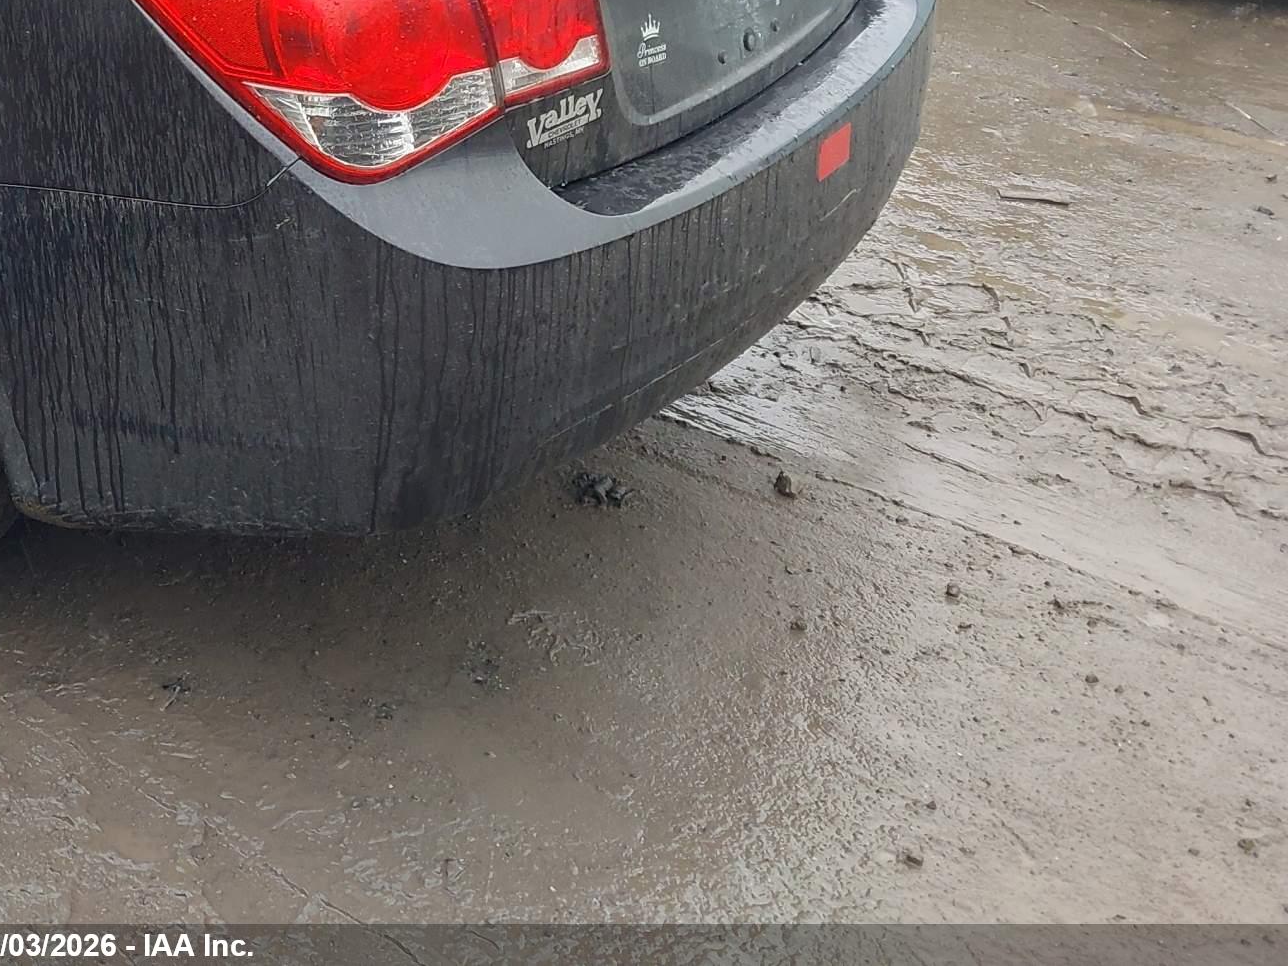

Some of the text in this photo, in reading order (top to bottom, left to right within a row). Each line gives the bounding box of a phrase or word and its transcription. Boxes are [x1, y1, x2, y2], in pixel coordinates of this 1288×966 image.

[636, 42, 667, 59] Princess
[638, 52, 667, 67] ON BOARD
[526, 88, 603, 149] Valley
